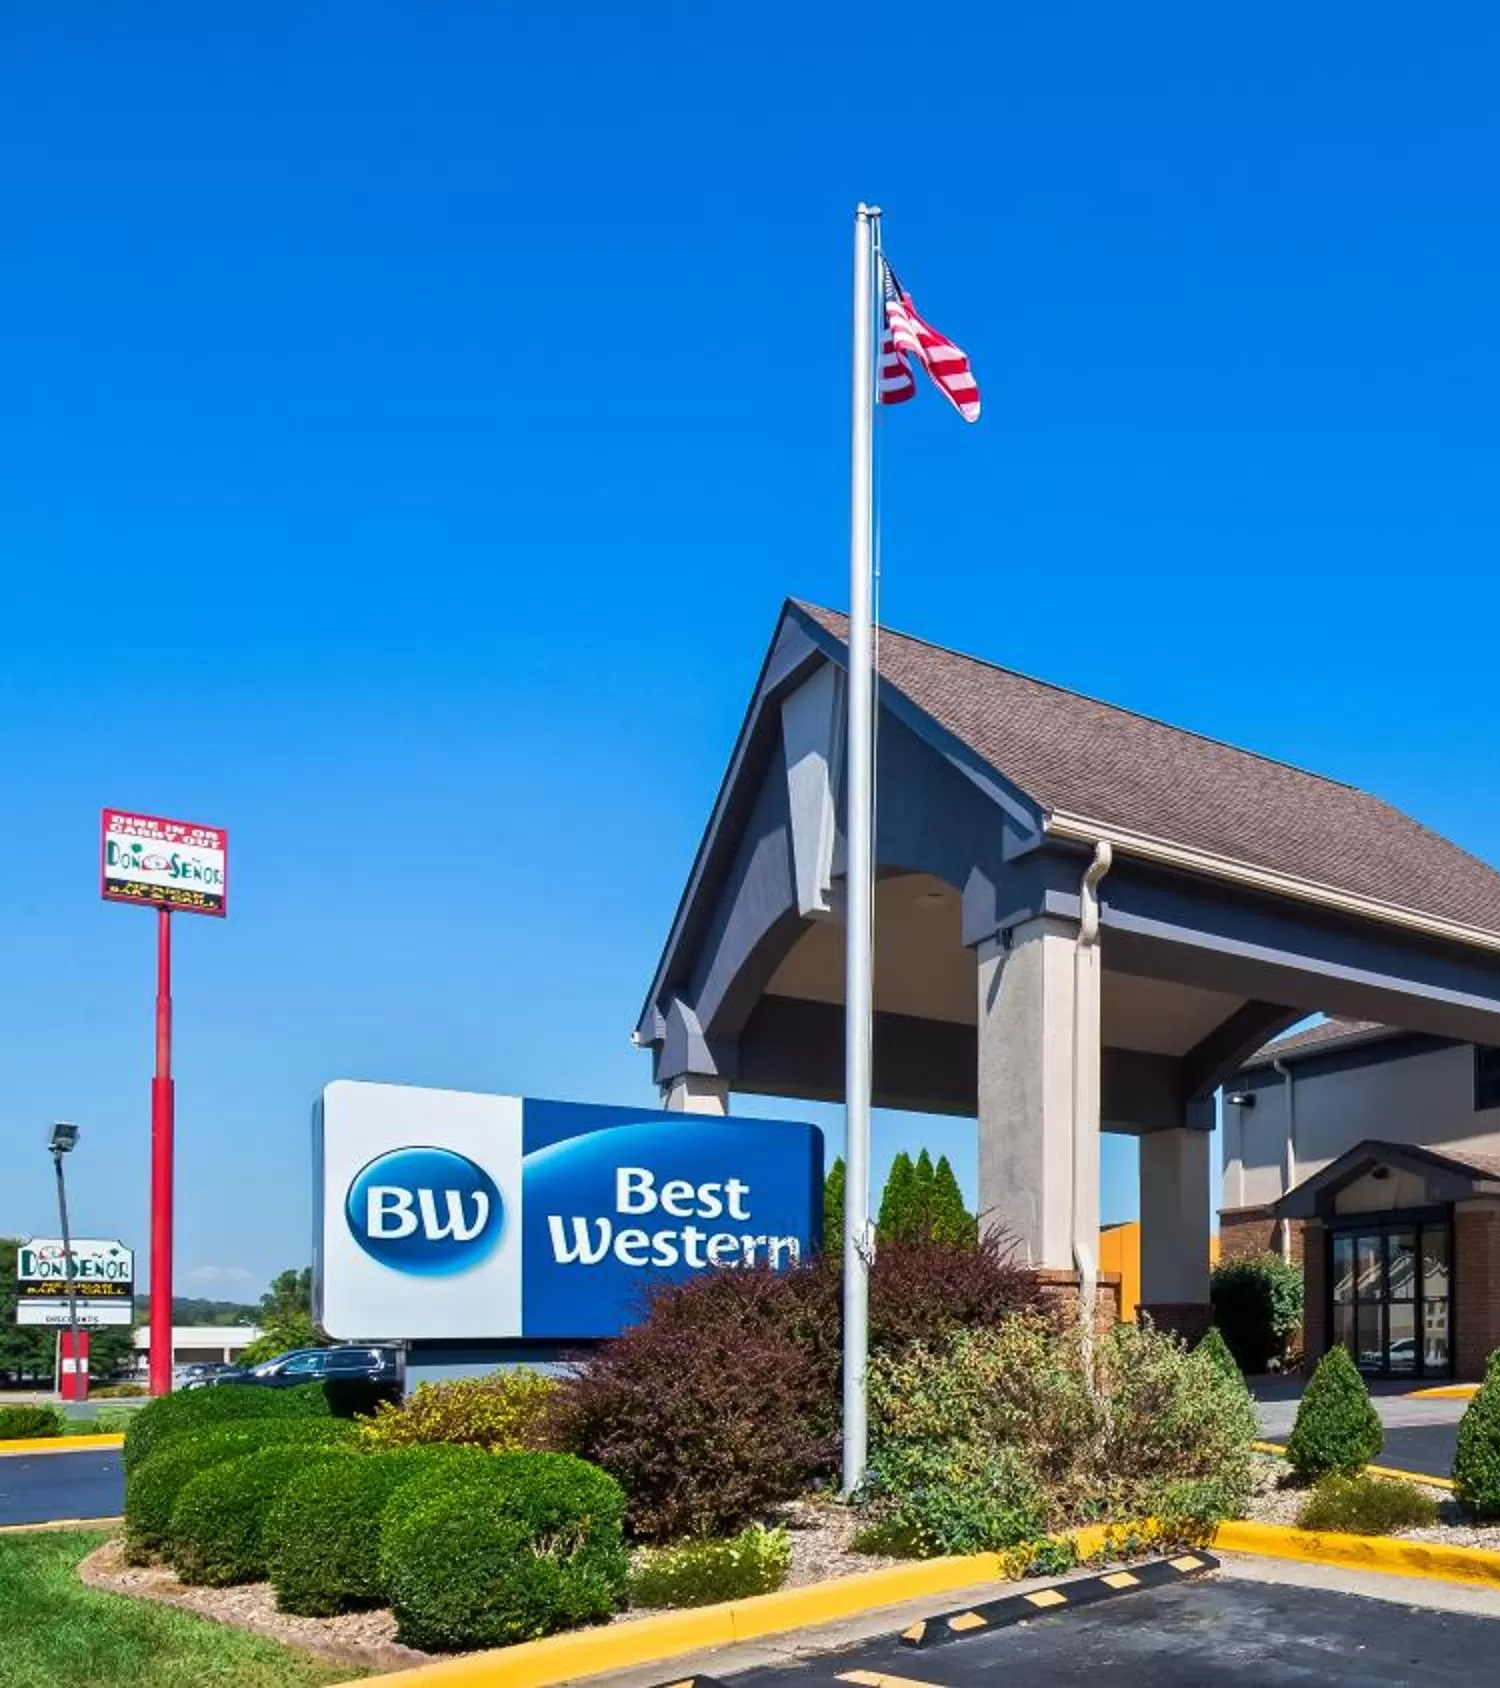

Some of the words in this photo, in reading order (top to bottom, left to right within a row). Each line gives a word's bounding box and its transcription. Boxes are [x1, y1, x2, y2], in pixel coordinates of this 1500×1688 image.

[109, 823, 177, 842] CARRY
[183, 836, 221, 849] OUT
[111, 815, 158, 829] DINE
[166, 824, 185, 835] IN
[191, 829, 219, 841] OR
[366, 1186, 489, 1241] BW
[616, 1167, 750, 1221] Best
[548, 1215, 801, 1270] Western
